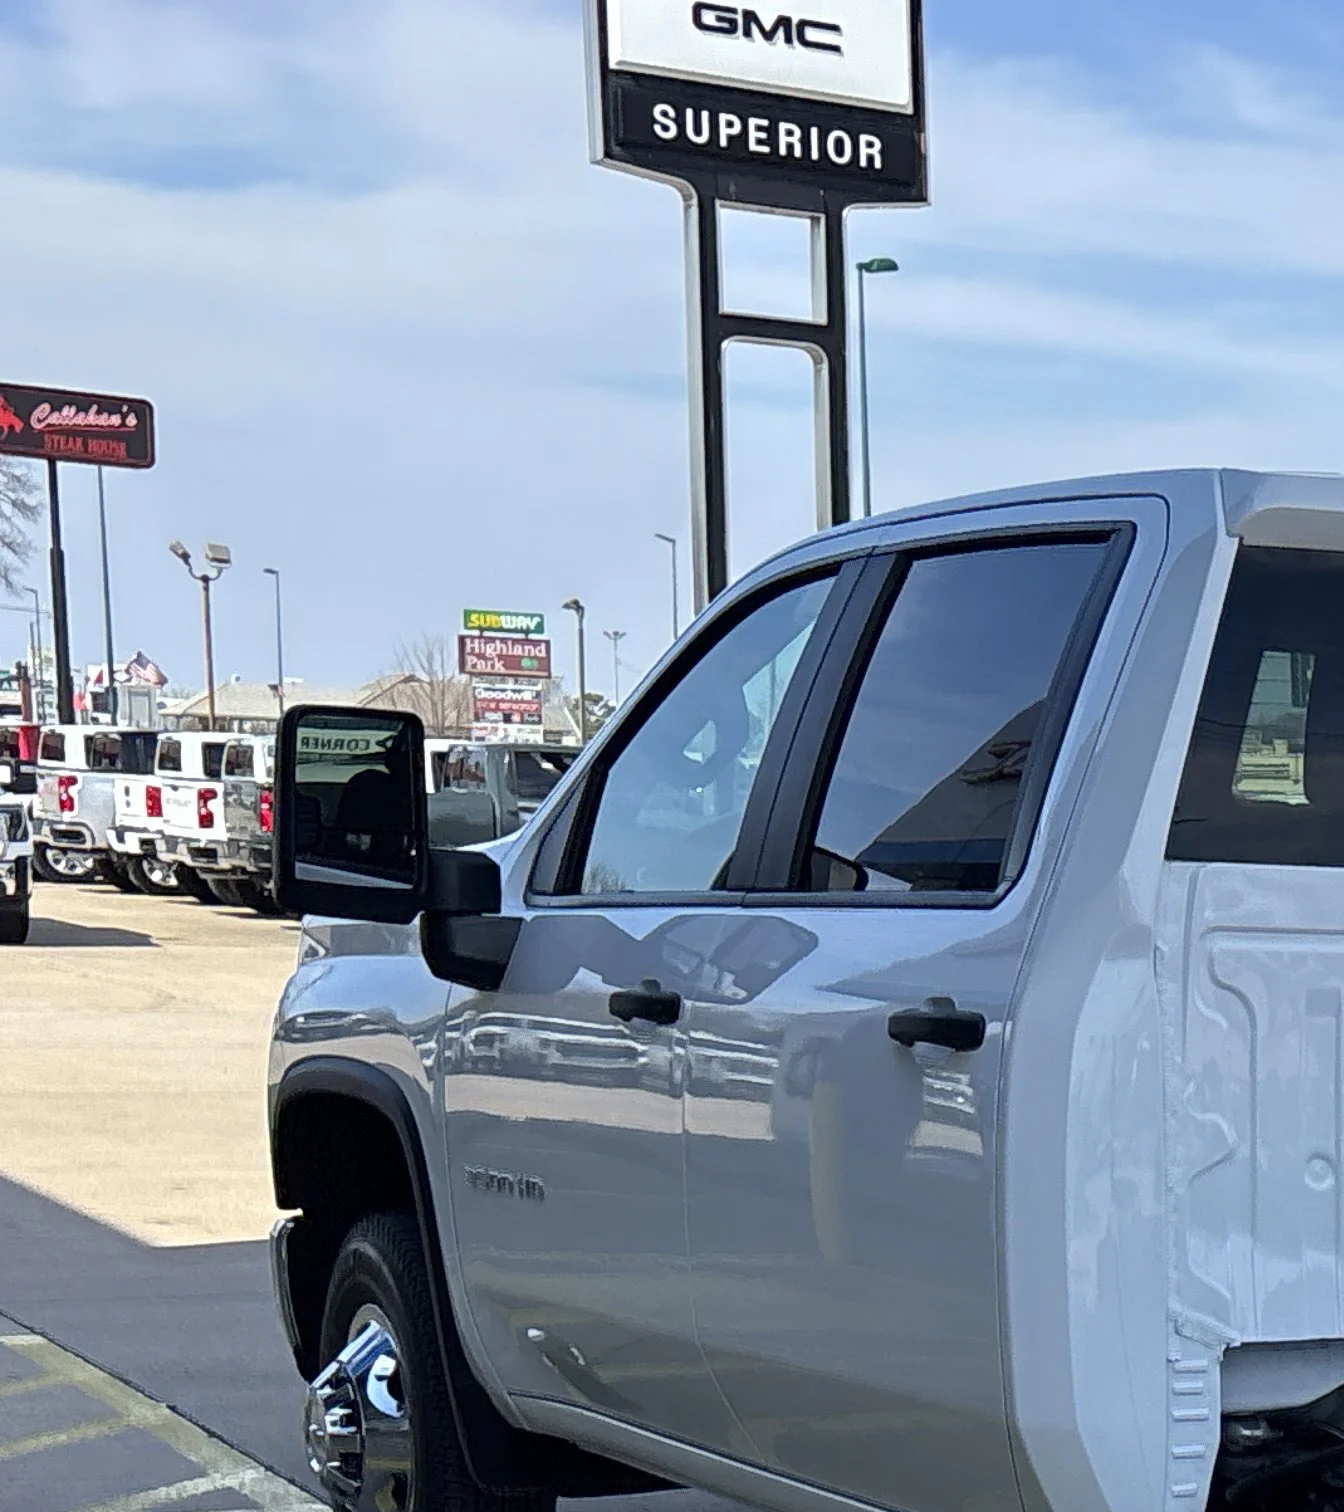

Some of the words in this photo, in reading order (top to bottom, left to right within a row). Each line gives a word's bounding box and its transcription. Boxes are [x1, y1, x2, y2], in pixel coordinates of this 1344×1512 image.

[692, 1, 842, 54] GMC
[653, 103, 882, 169] SUPERIOR
[44, 433, 84, 452] STEAK
[88, 438, 128, 459] HOUSE
[467, 612, 541, 630] SUBWAY
[464, 637, 547, 658] Highland
[465, 654, 507, 672] Park
